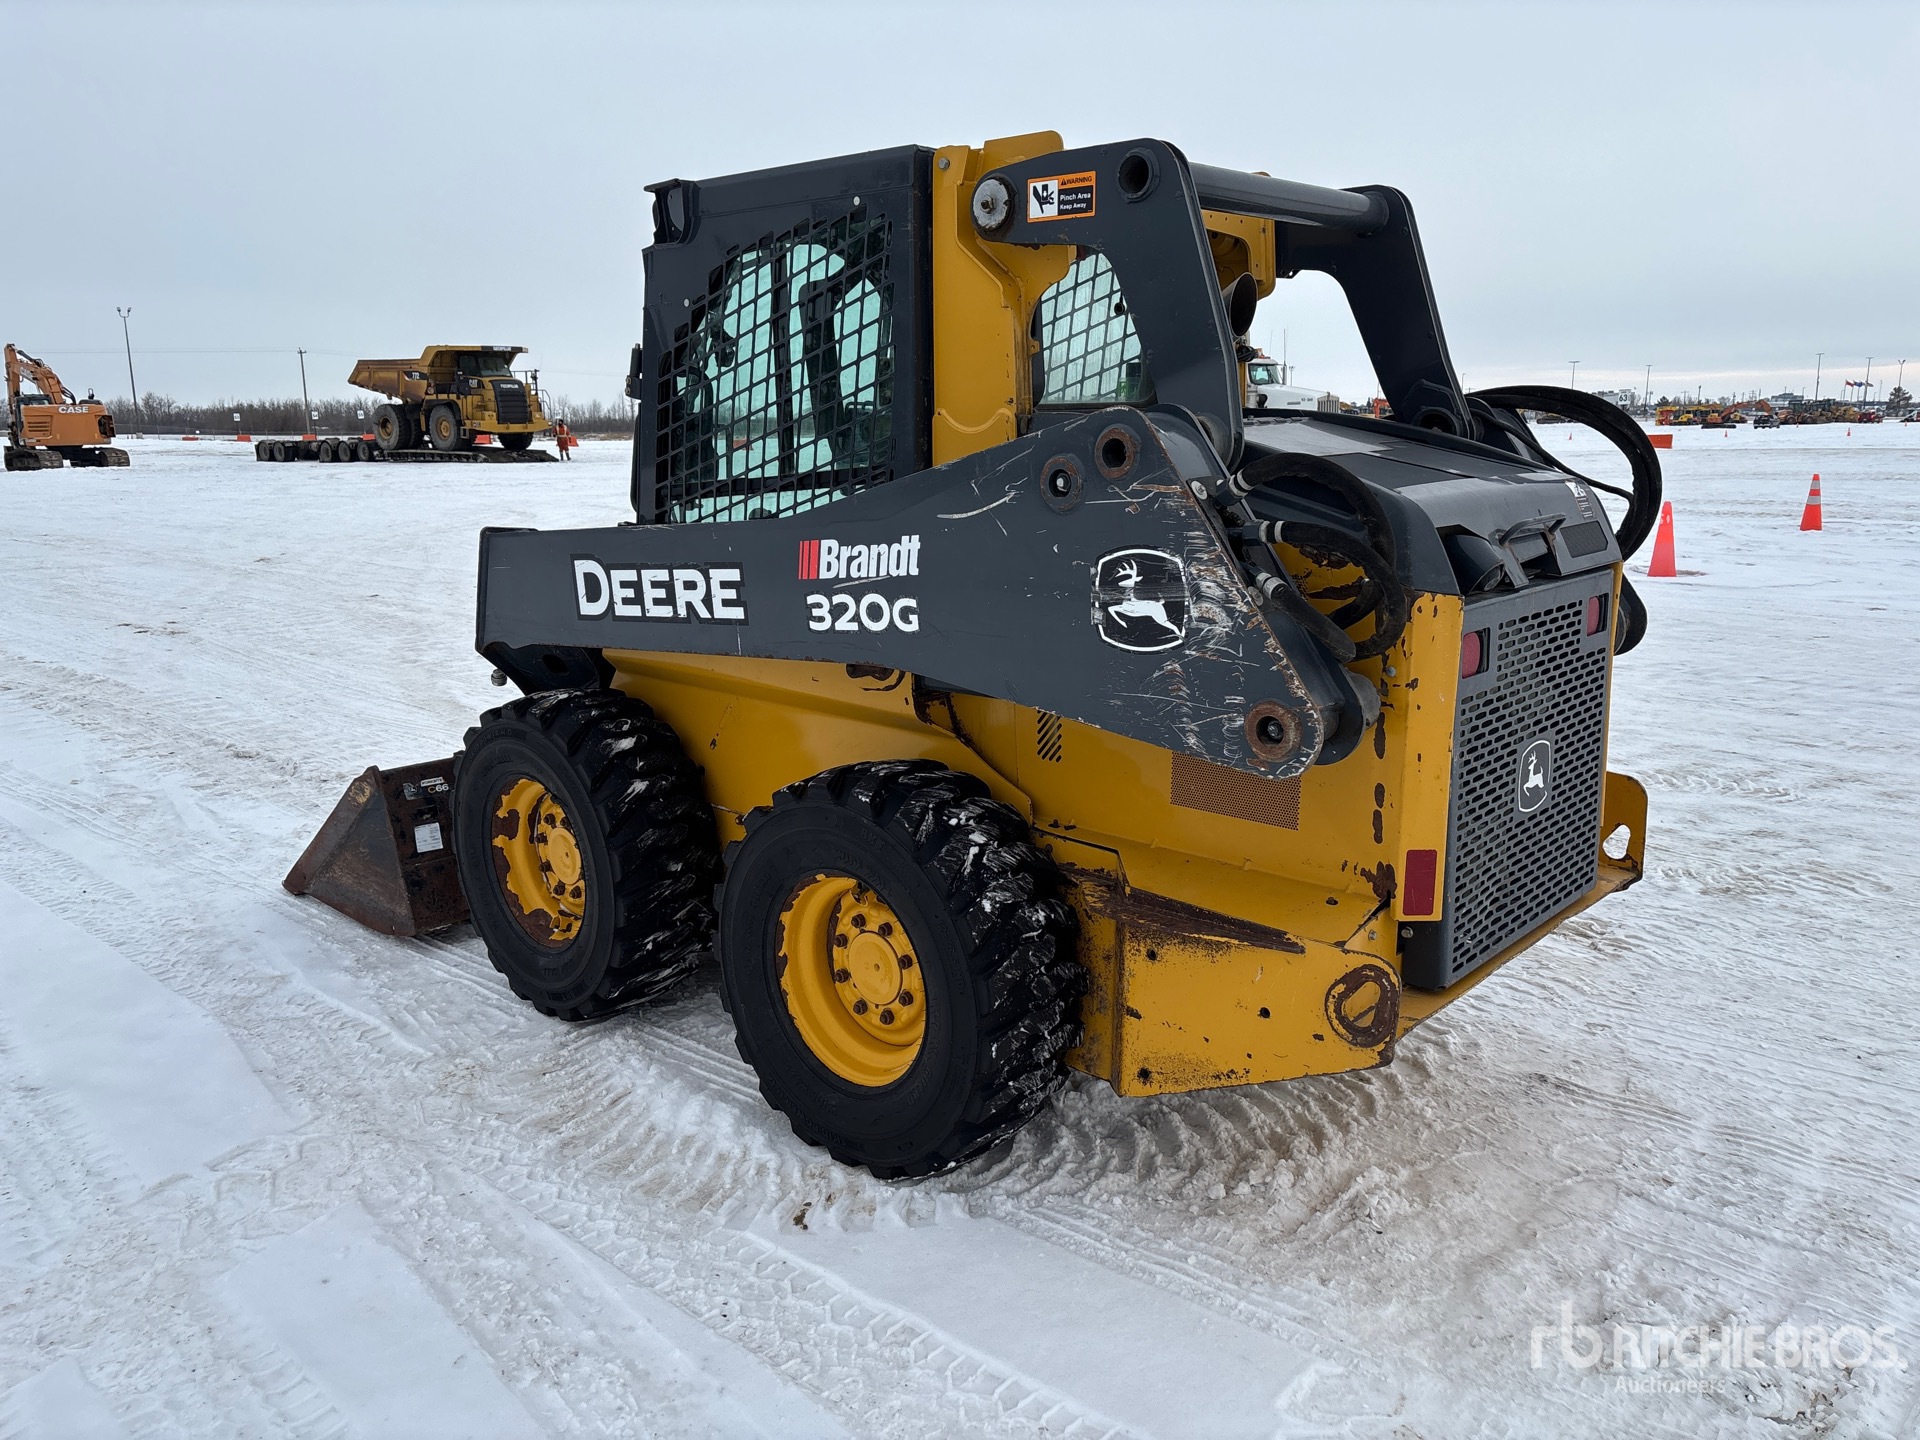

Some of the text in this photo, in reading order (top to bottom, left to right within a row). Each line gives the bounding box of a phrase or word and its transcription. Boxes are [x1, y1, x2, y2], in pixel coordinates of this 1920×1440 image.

[1067, 176, 1092, 184] WARNING
[469, 379, 478, 388] CAT
[58, 406, 89, 414] CASE
[819, 534, 921, 580] Brandt
[574, 559, 745, 621] DEERE
[806, 593, 920, 633] 320G
[427, 783, 449, 794] C66
